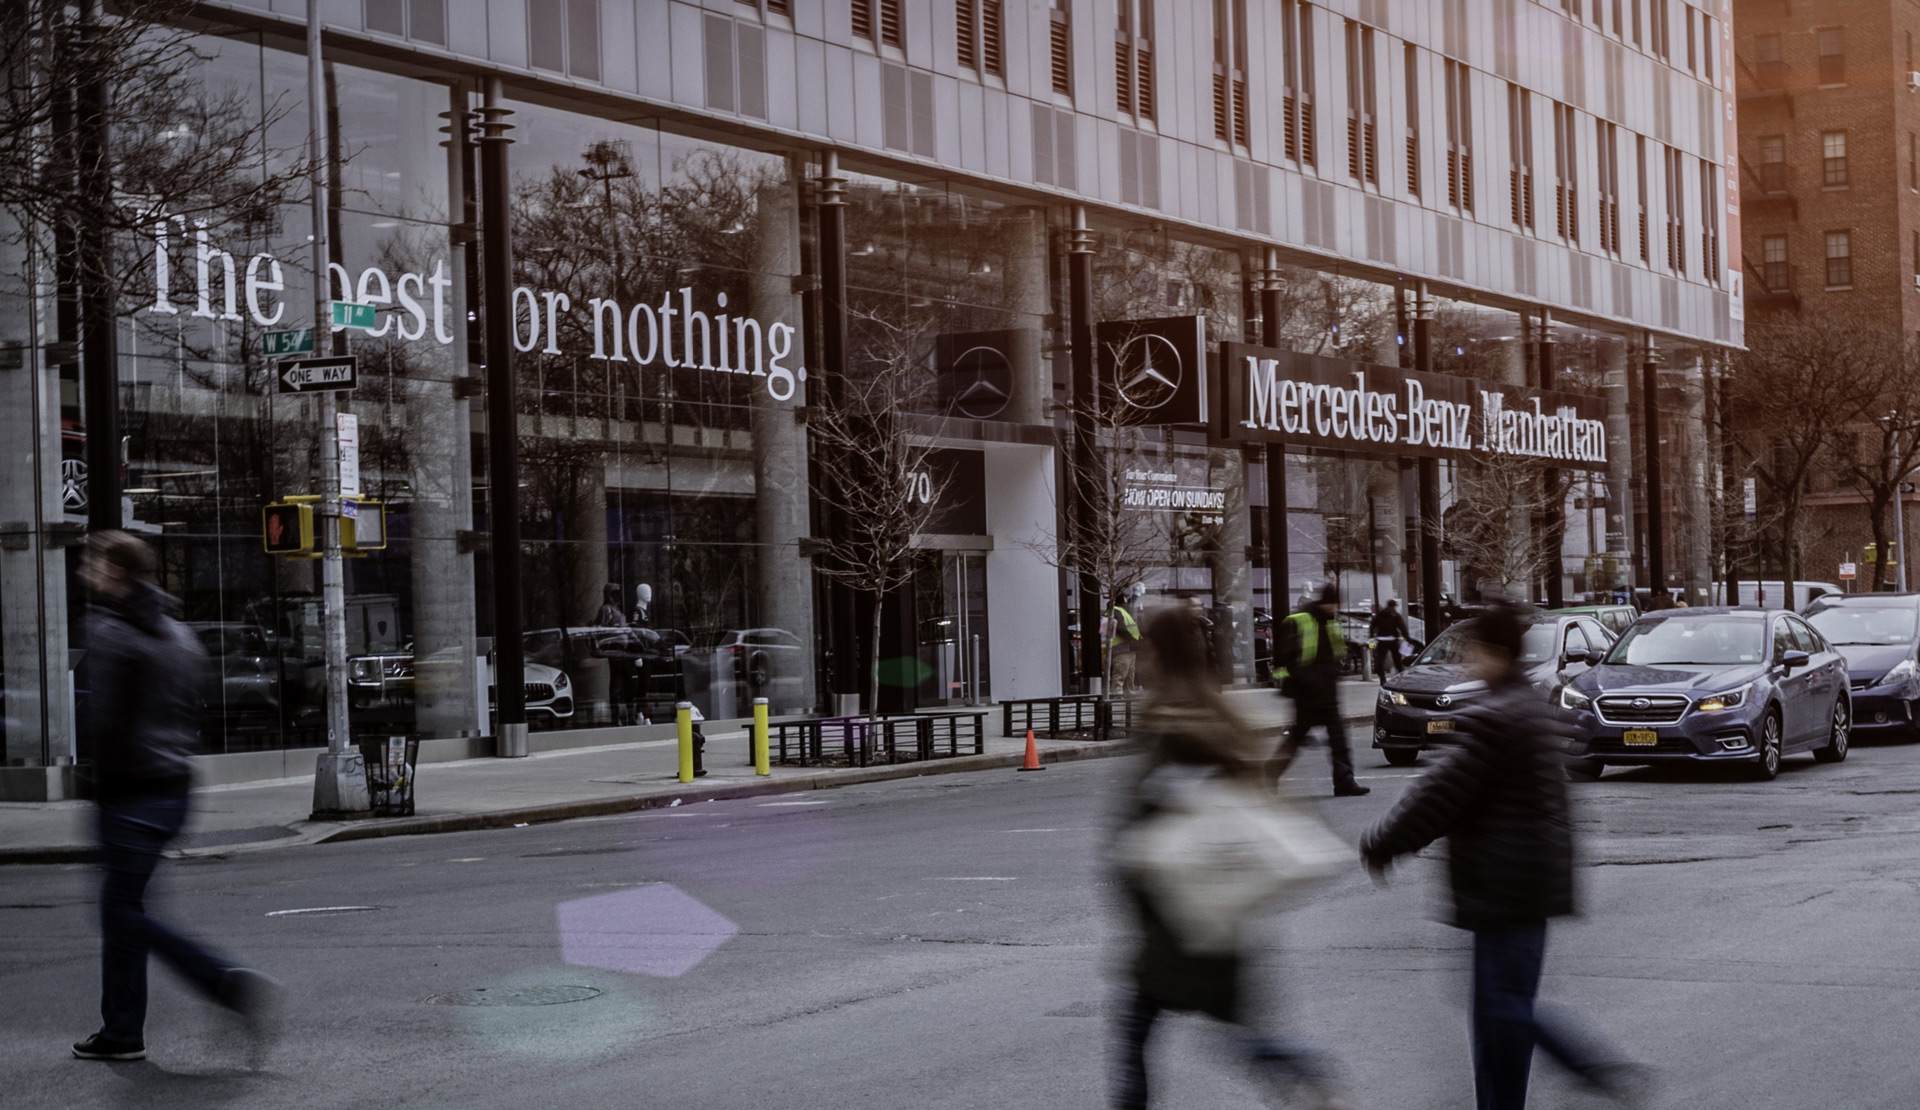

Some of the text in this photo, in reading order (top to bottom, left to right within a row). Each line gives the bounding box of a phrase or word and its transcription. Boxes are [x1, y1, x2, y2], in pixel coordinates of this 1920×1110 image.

[136, 208, 285, 326] The
[512, 287, 570, 355] or
[589, 286, 807, 401] nothing.
[344, 305, 353, 324] 11
[266, 334, 276, 352] W
[282, 332, 302, 351] 54
[290, 368, 346, 383] ONE WAY
[1242, 356, 1608, 463] Mercedes-Benz Manhattan
[906, 472, 930, 504] 70
[1125, 488, 1225, 509] NOW OPEN ON SUNDAYS!
